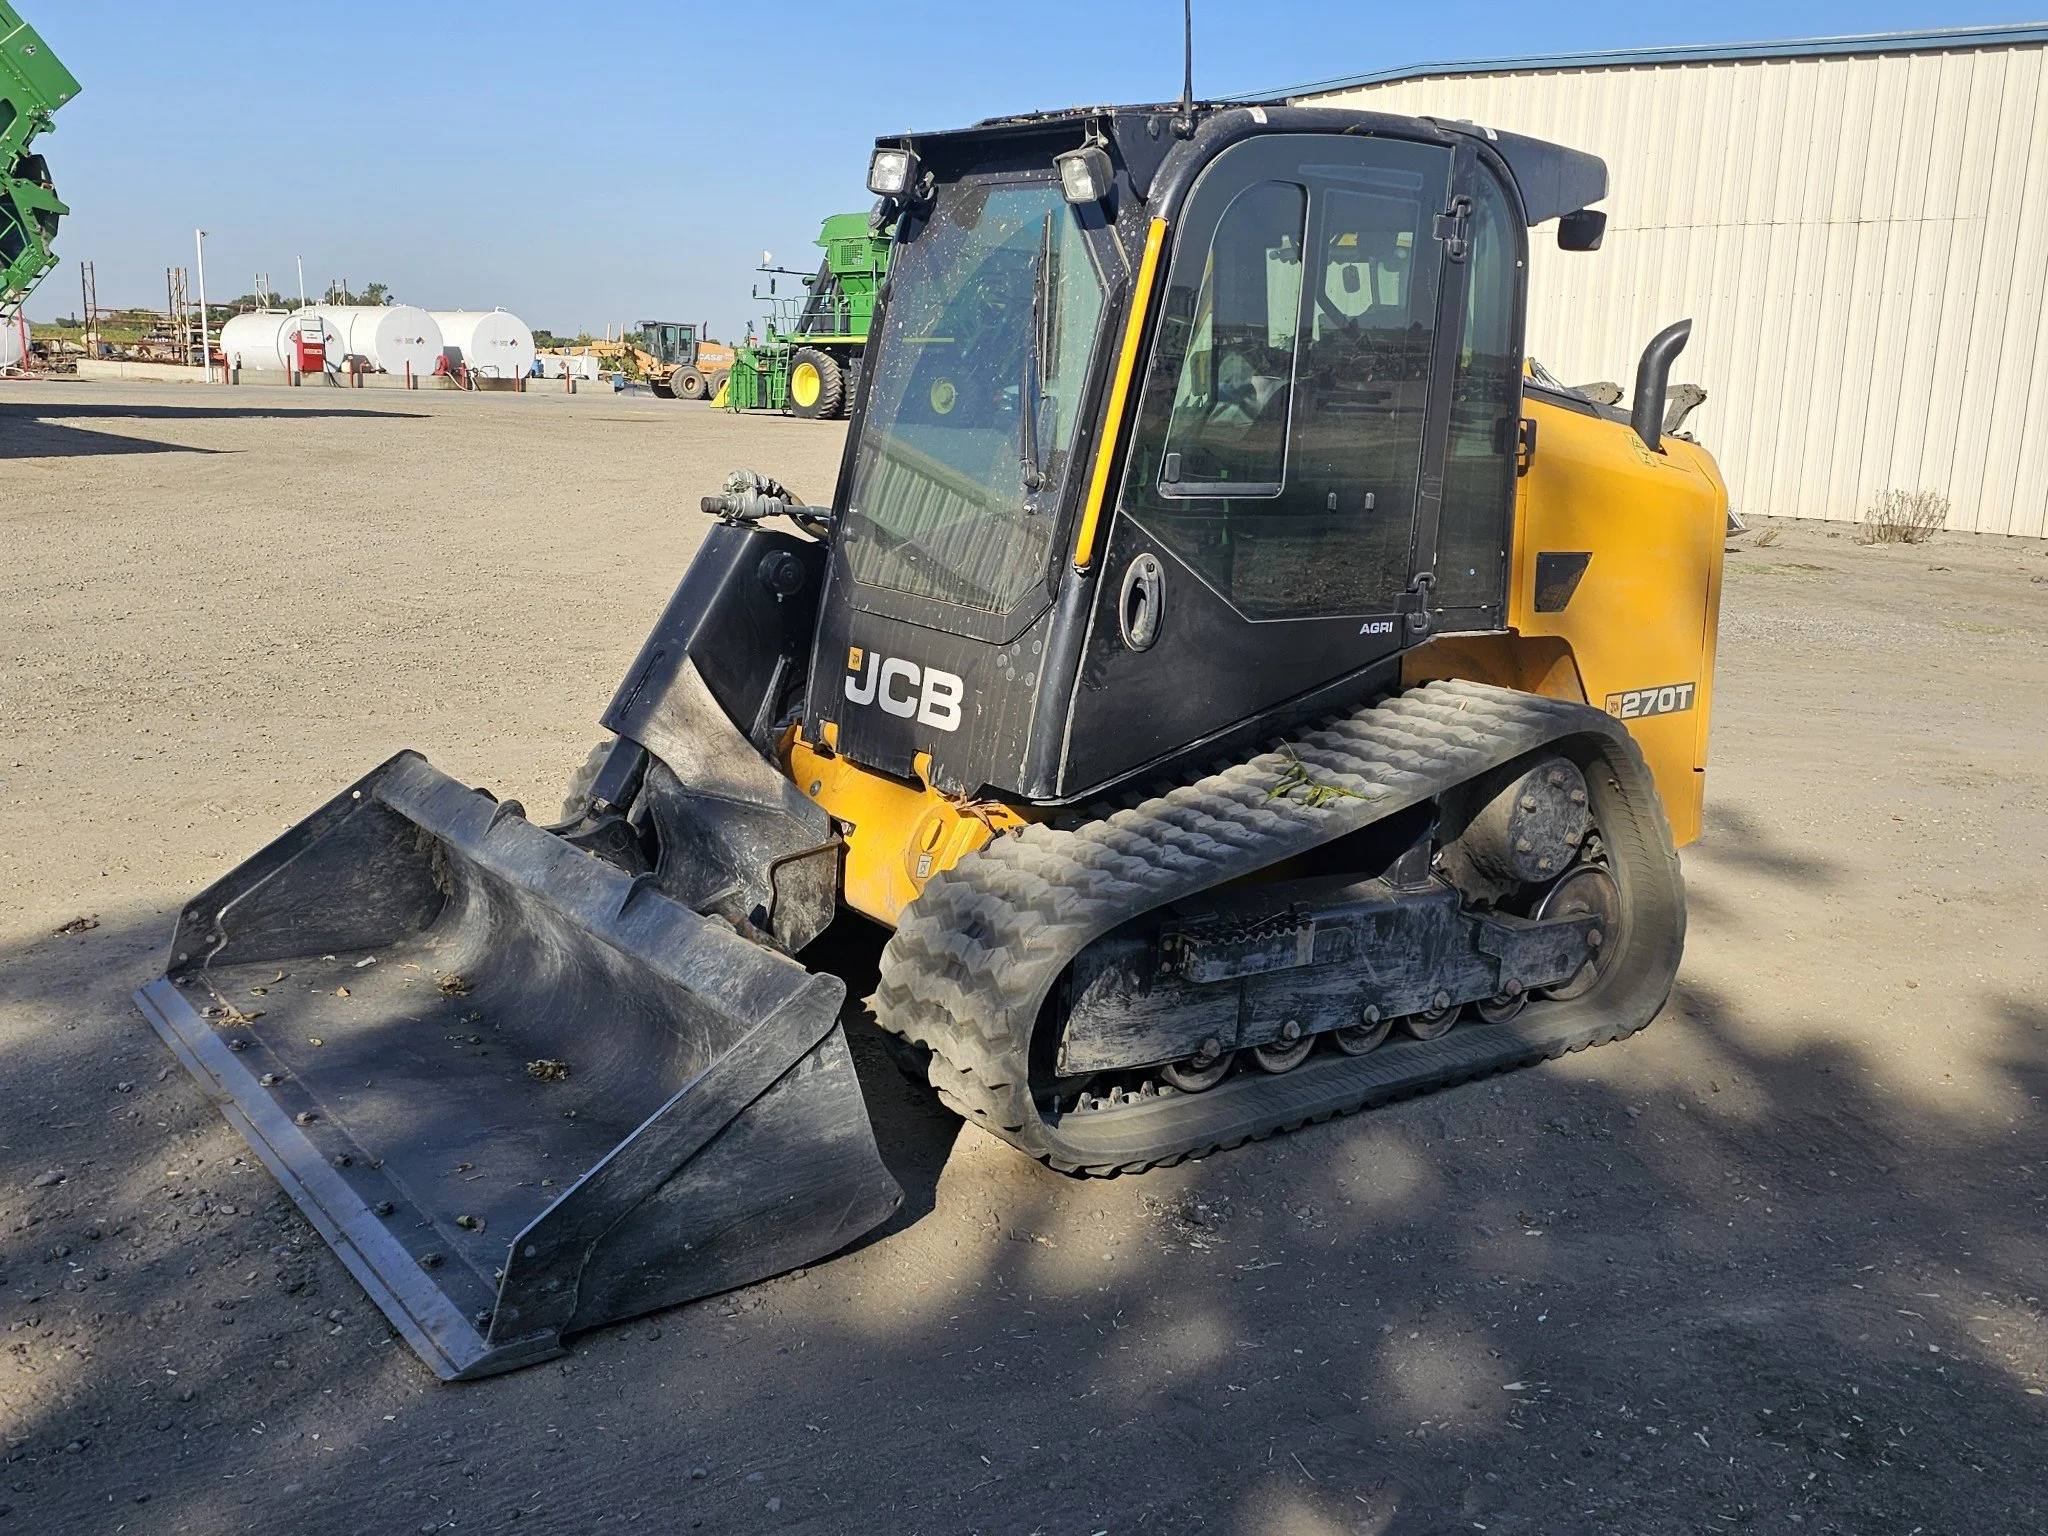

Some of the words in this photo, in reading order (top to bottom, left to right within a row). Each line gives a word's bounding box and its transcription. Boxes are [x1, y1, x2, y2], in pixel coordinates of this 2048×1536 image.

[698, 352, 723, 361] CASE
[1359, 621, 1394, 635] AGRI
[844, 651, 964, 732] JCB
[1621, 684, 1693, 719] 270T
